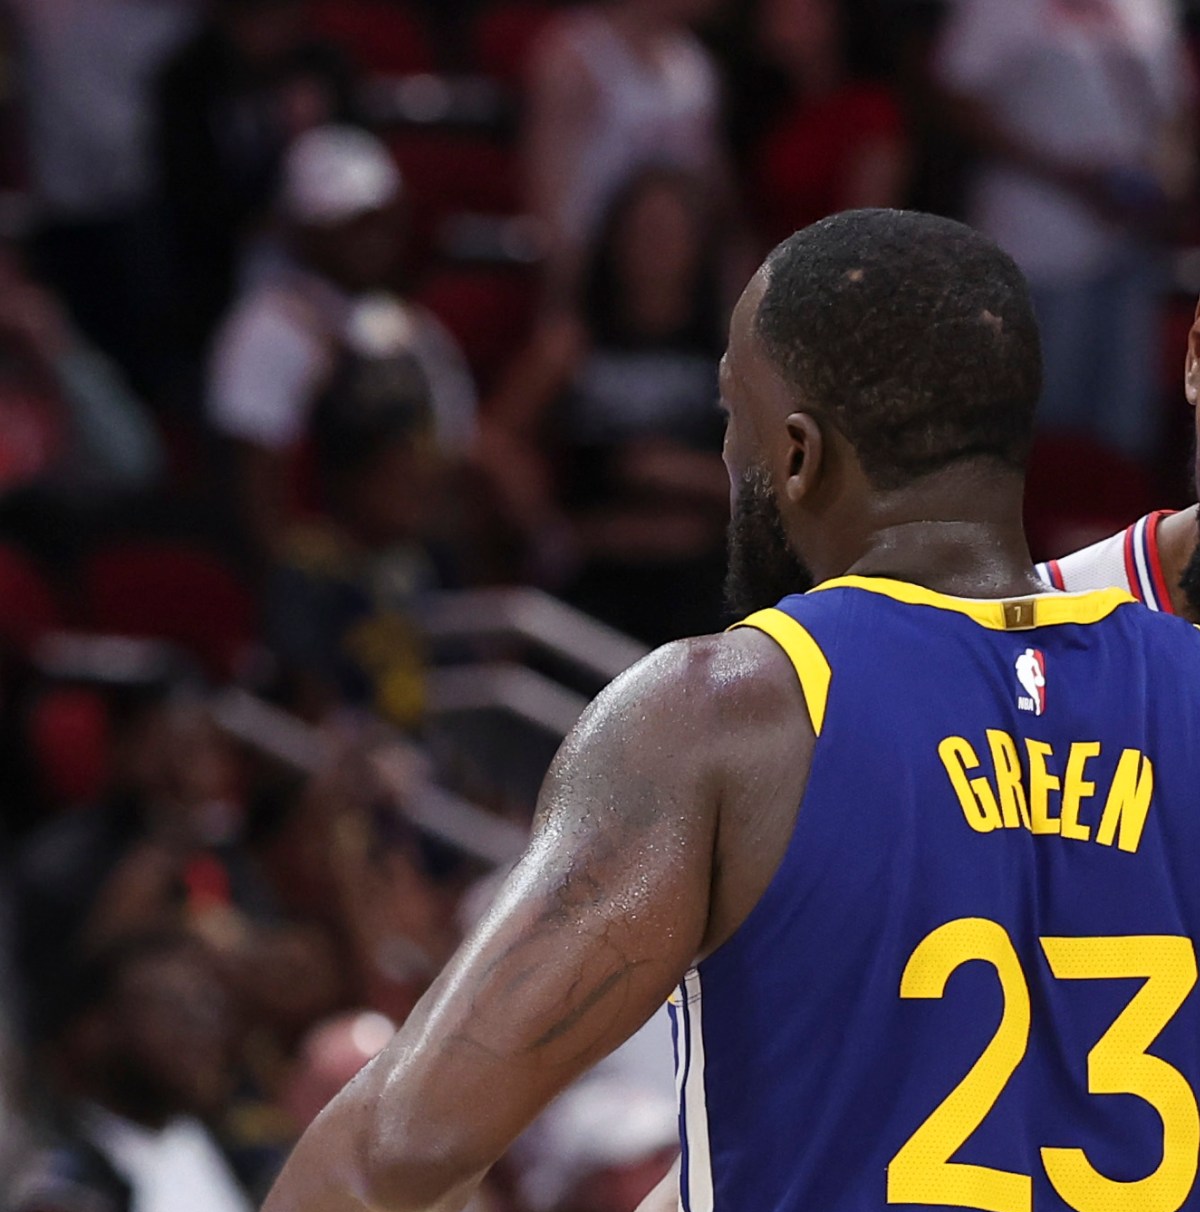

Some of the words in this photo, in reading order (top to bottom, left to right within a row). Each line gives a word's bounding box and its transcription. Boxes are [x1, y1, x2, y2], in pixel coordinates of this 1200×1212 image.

[1013, 605, 1022, 623] 7
[1018, 696, 1034, 711] NBA
[938, 728, 1154, 854] GREEN
